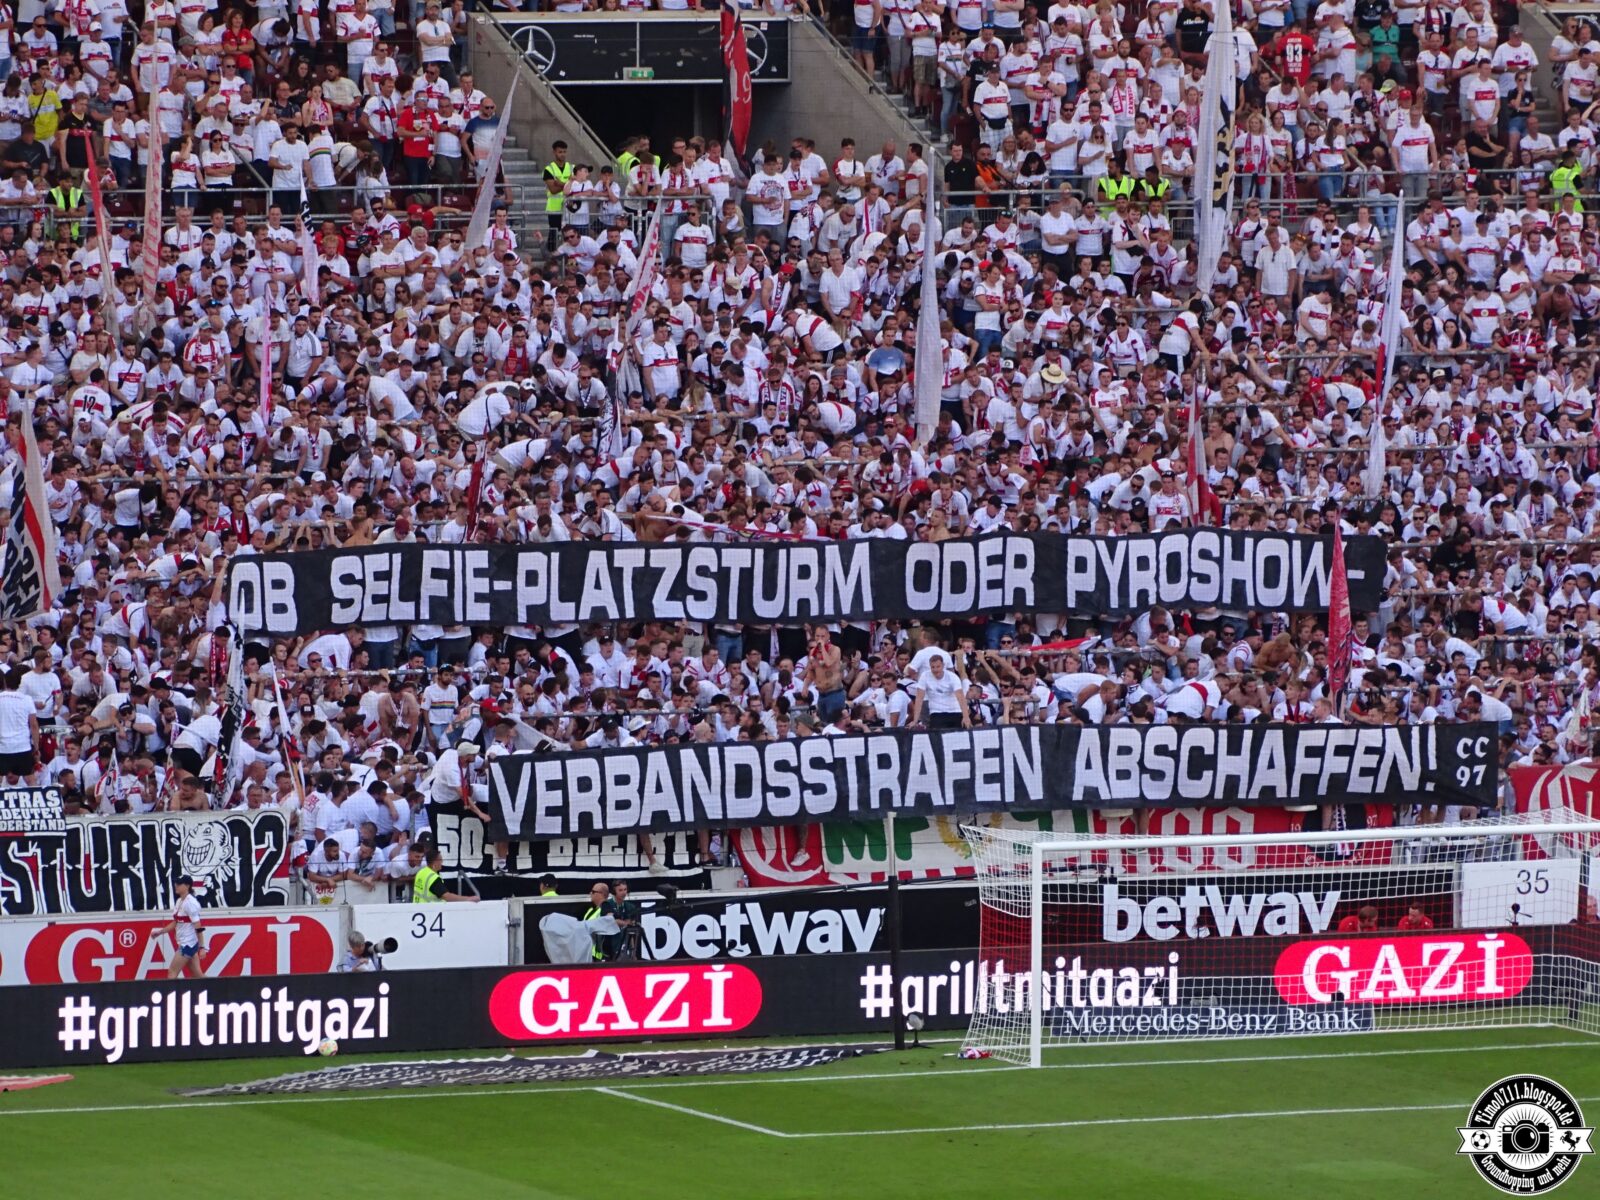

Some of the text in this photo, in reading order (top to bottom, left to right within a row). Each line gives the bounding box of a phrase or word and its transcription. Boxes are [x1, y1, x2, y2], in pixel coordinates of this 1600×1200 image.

[82, 394, 96, 416] 12
[228, 533, 1366, 633] OB SELFIE-PLATZSTURM ODER PYROSHOW-
[1456, 736, 1490, 759] CC
[488, 725, 1438, 836] VERBANDSSTRAFEN ABSCHAFFEN!
[1456, 764, 1487, 787] 97
[0, 790, 60, 809] TRAS
[0, 807, 63, 820] DEUTET
[222, 811, 289, 908] 02
[1516, 869, 1550, 895] 35
[411, 912, 446, 938] 34
[1102, 884, 1341, 942] betway
[641, 902, 886, 960] betway
[58, 982, 390, 1063] #grilltmitgazi
[1065, 1003, 1361, 1035] Mercedes-Benz Bank
